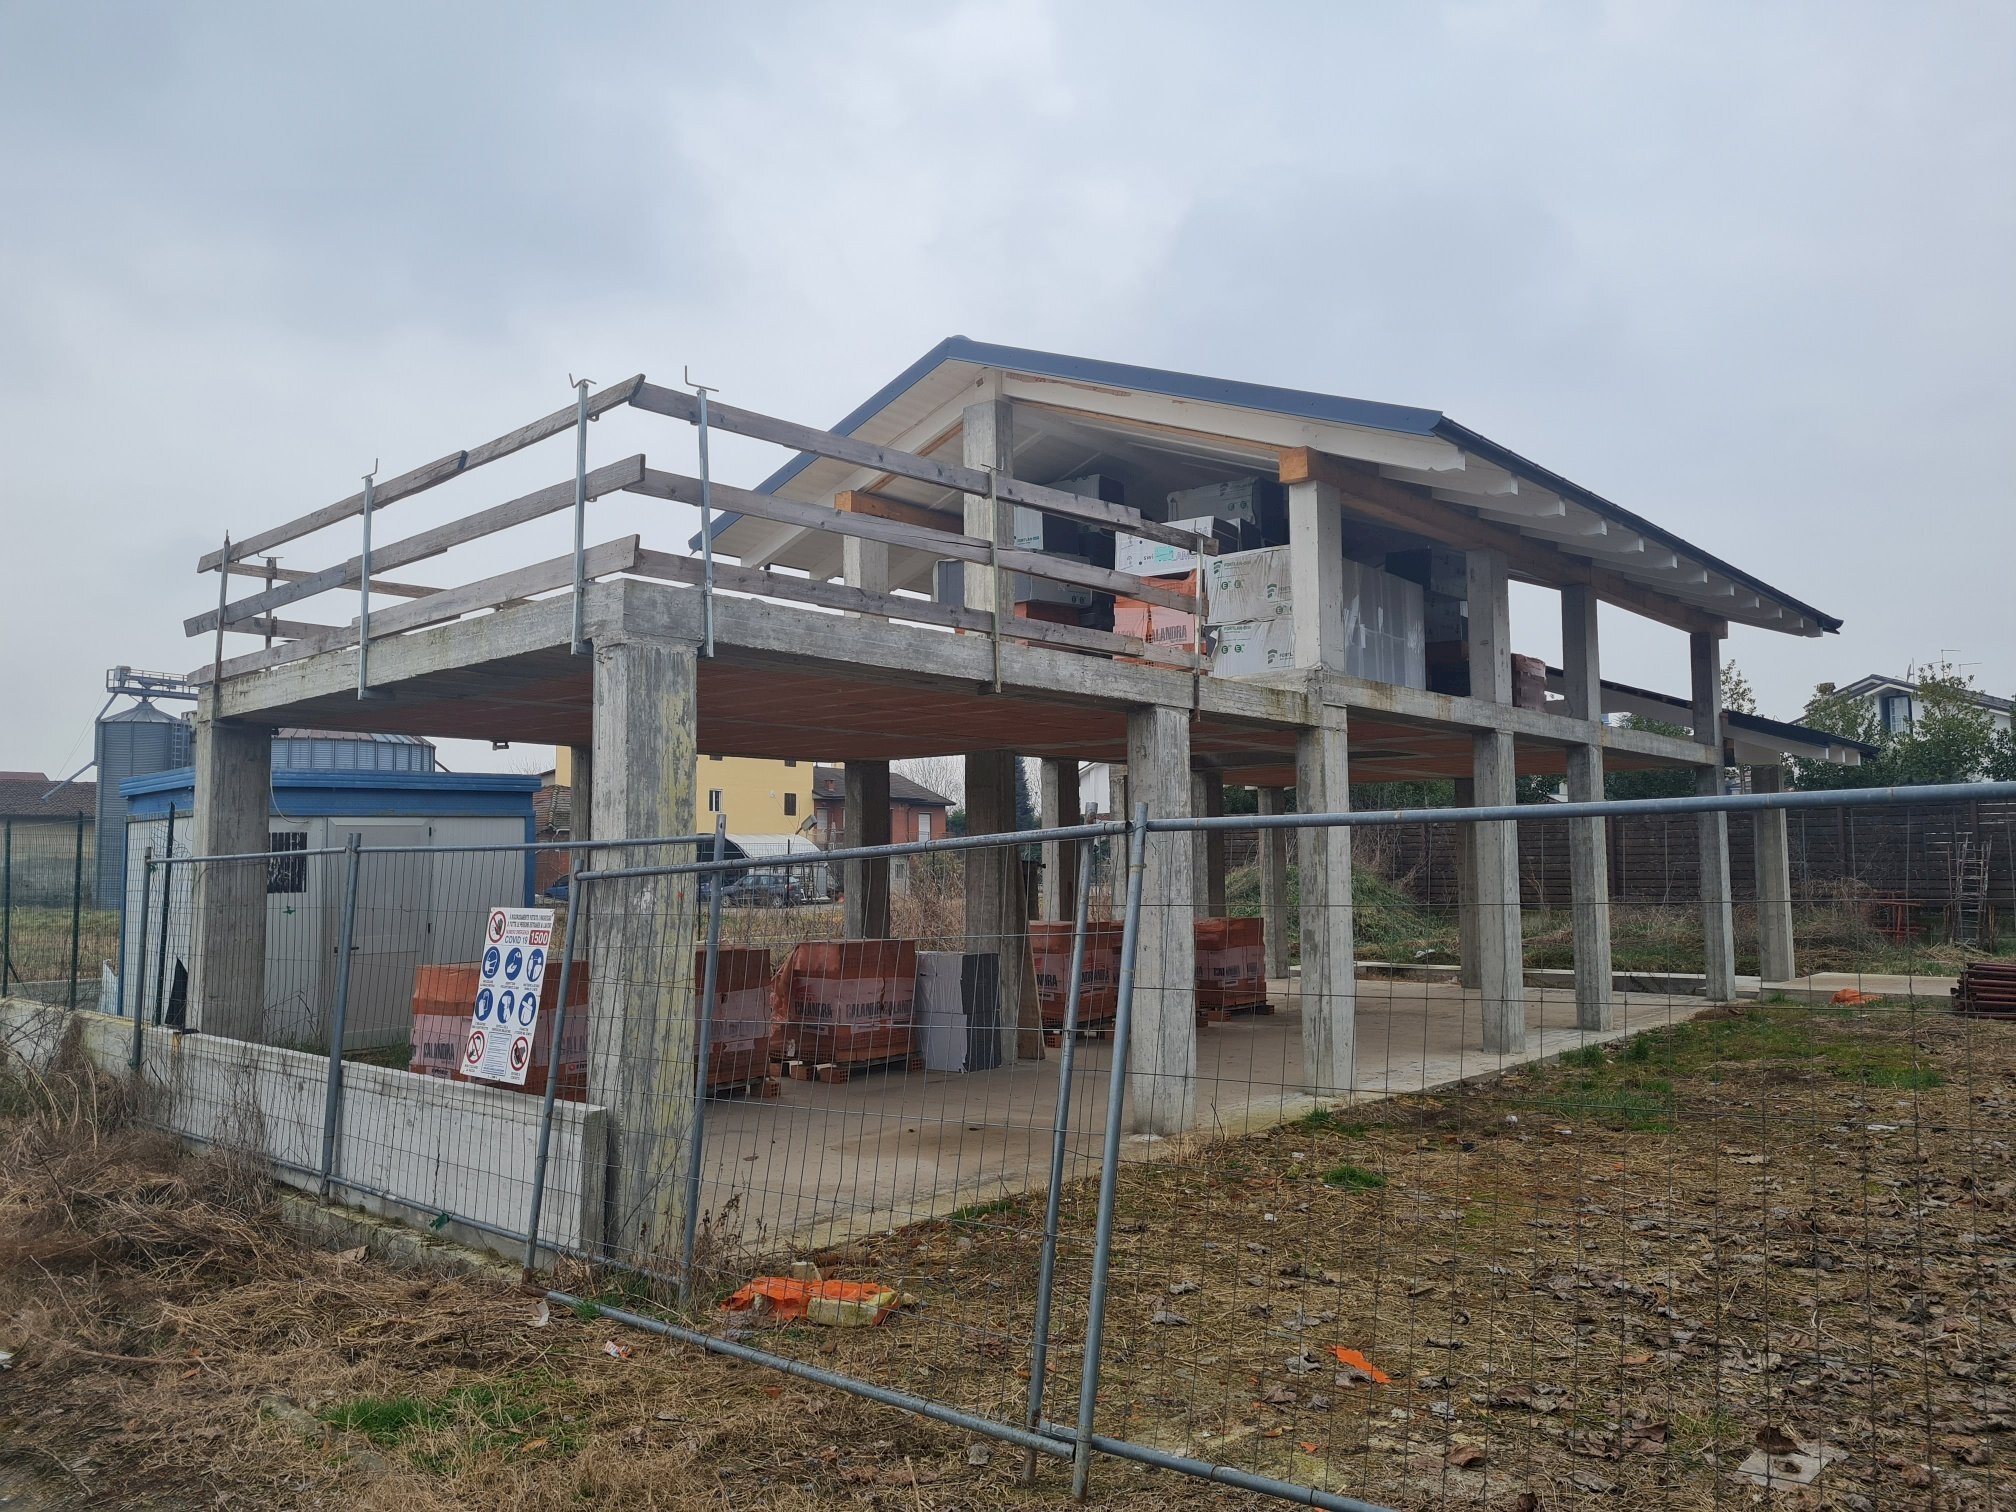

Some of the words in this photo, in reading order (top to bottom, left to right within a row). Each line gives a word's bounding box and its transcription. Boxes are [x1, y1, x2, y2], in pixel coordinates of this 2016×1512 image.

[1151, 625, 1187, 641] ALANDRA
[505, 935, 521, 944] COVID
[522, 936, 528, 946] 19
[530, 931, 549, 945] 1500
